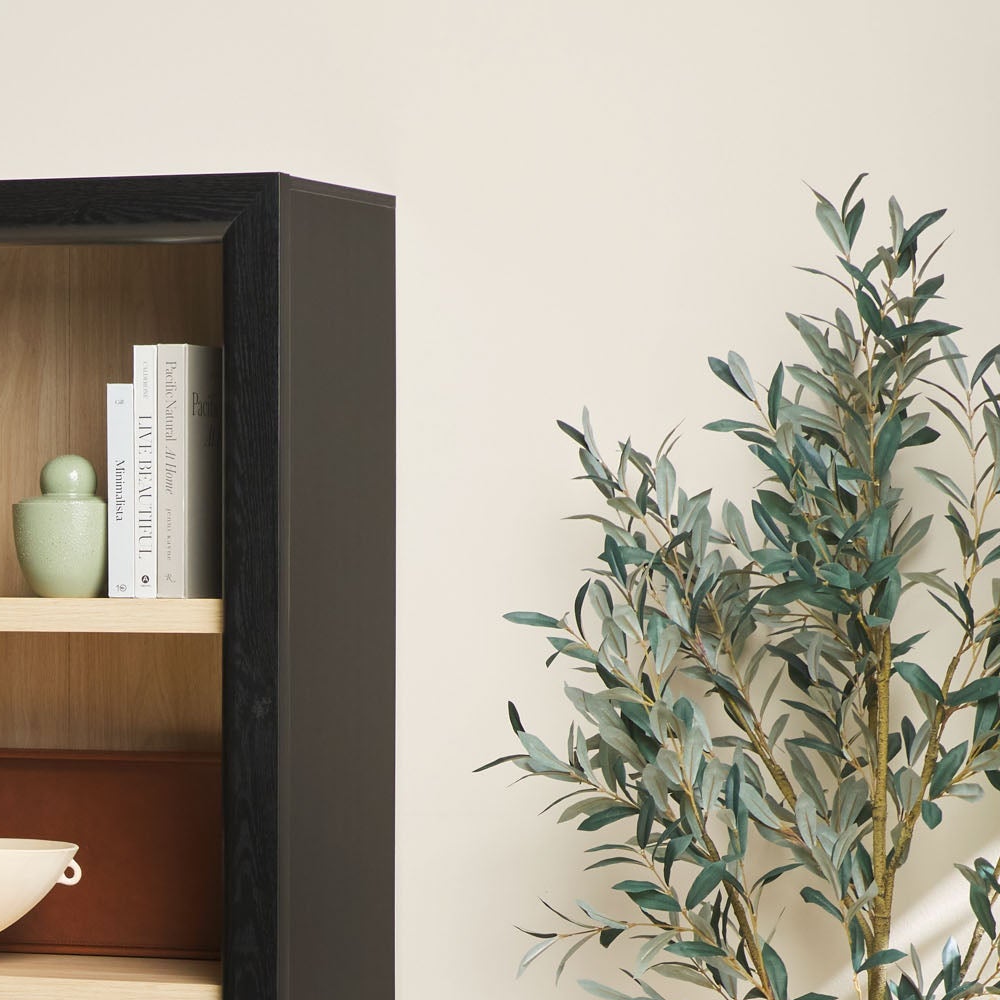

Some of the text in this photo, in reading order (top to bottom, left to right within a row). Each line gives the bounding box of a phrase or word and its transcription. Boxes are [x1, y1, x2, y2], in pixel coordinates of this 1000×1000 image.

[115, 460, 126, 521] Minimalista
[138, 416, 152, 559] LIVE BEAUTIFUL
[165, 361, 177, 495] Pacific Natural At Home
